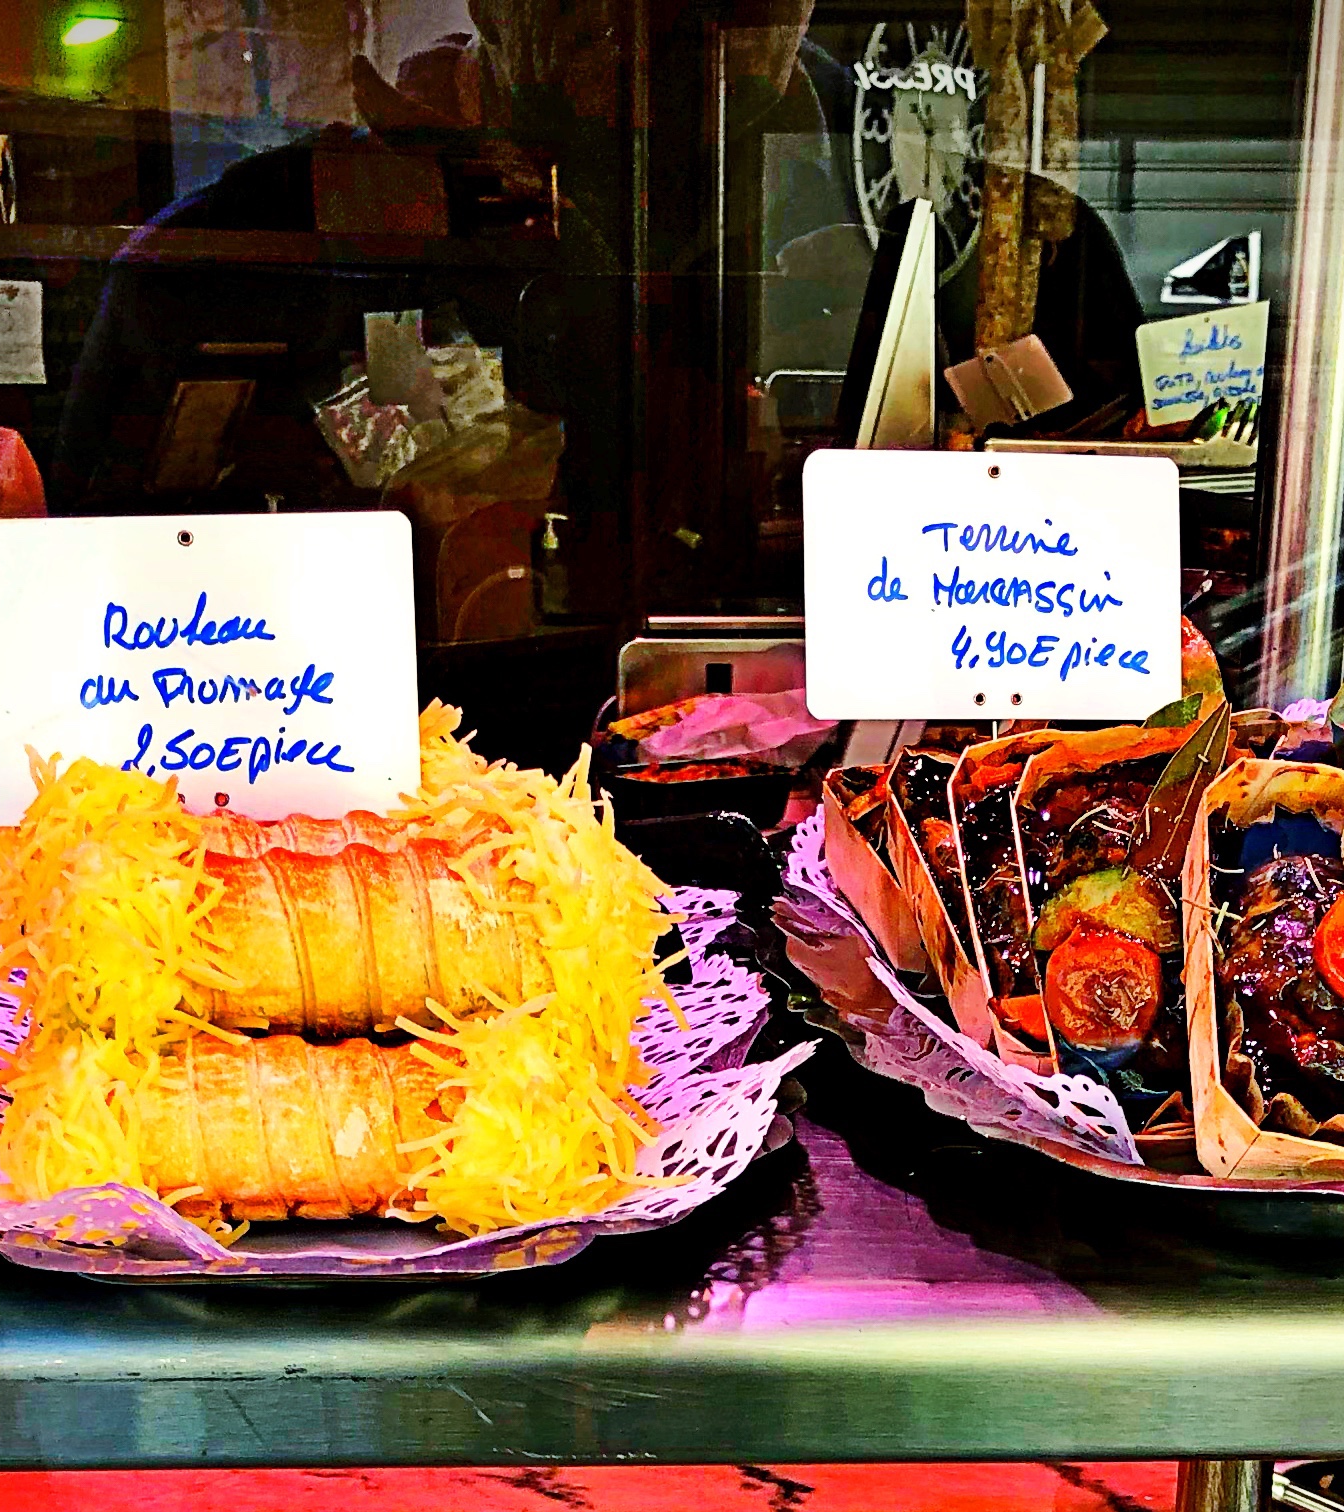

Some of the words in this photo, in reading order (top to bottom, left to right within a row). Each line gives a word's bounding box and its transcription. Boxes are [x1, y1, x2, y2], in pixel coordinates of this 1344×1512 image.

[922, 519, 1077, 557] Terrine
[867, 556, 908, 602] de
[104, 592, 276, 650] Rouleau
[80, 675, 139, 709] au
